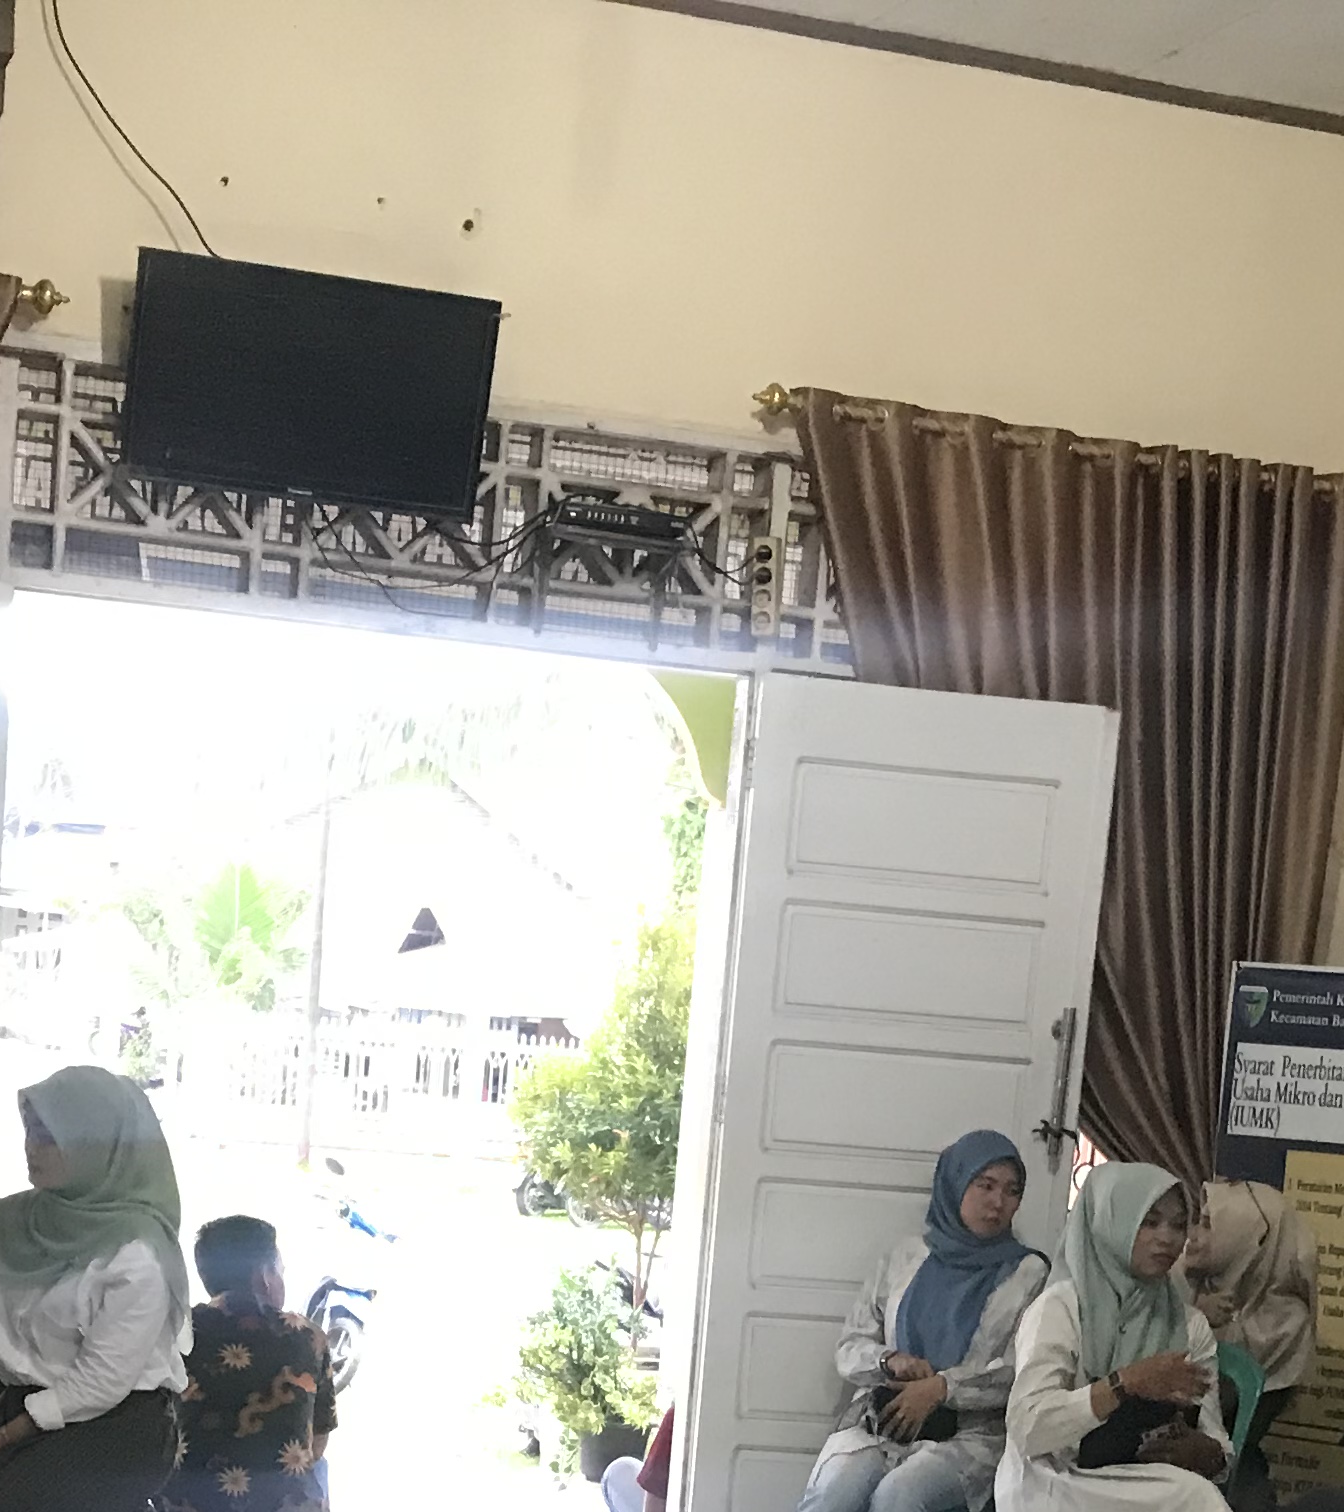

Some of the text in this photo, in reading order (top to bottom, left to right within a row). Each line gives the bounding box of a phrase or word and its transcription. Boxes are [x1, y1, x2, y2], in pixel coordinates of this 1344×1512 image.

[1272, 989, 1334, 1007] Pemerintah
[1270, 1010, 1329, 1027] Kecamatan
[1233, 1052, 1275, 1078] Syarat
[1232, 1077, 1272, 1102] Usaha
[1274, 1081, 1316, 1106] Mikro
[1318, 1088, 1344, 1109] dan
[1229, 1105, 1281, 1136] (IUMK)
